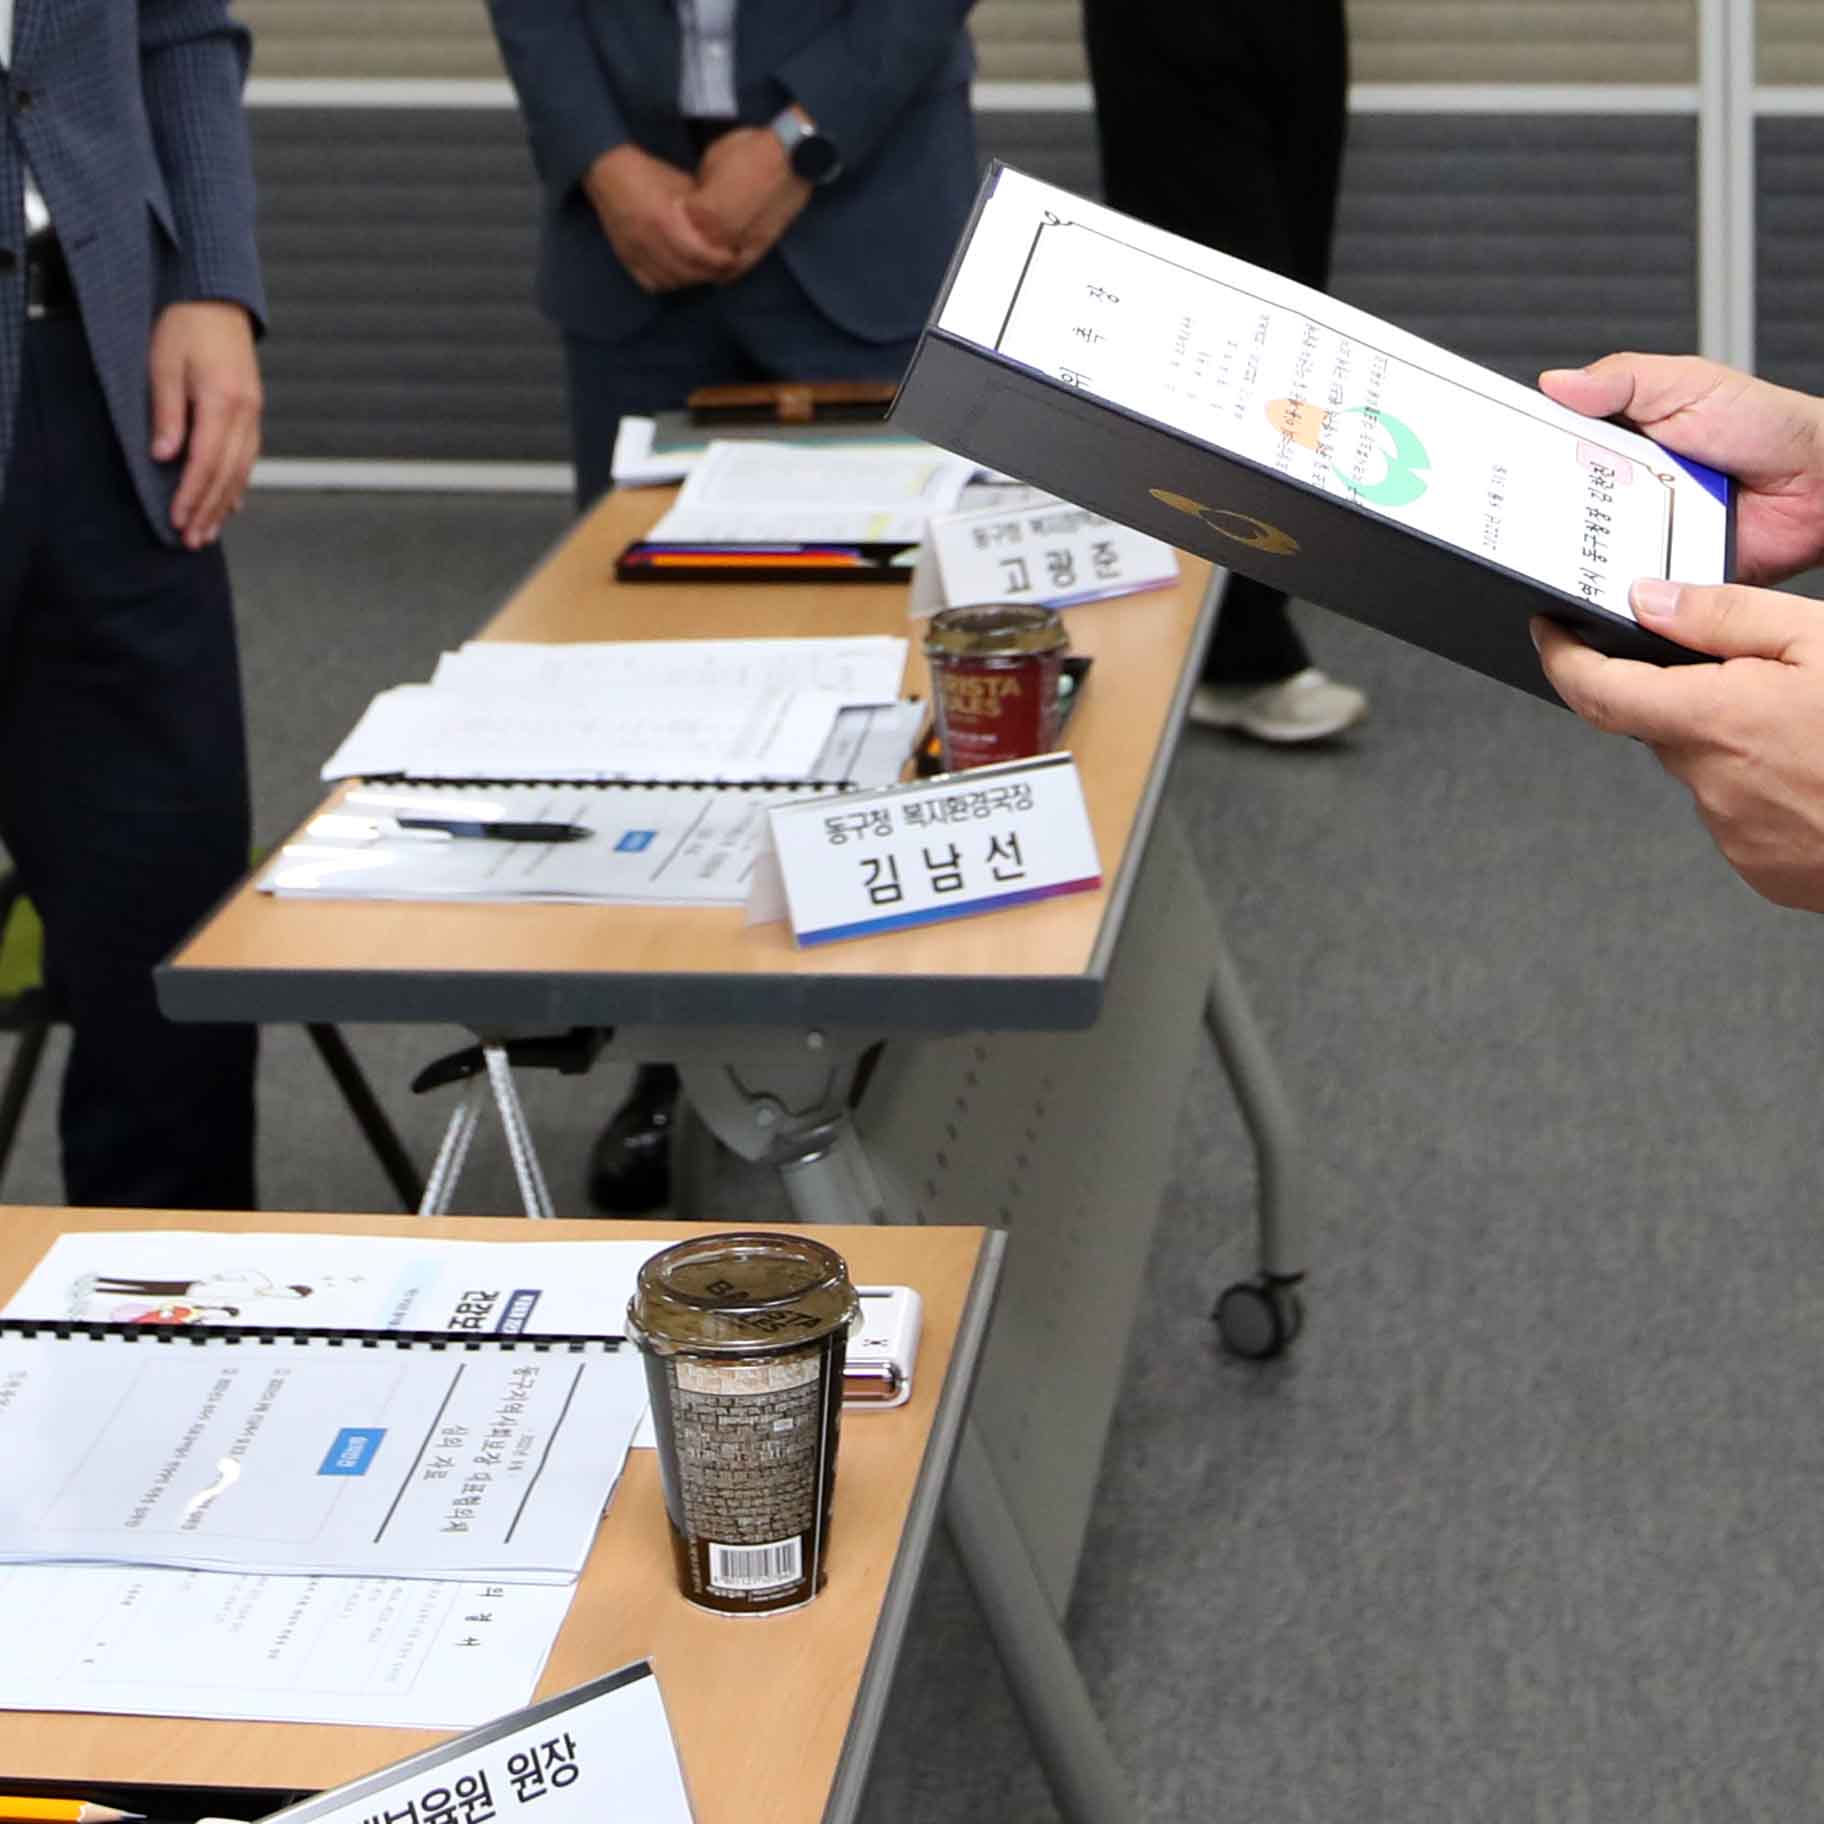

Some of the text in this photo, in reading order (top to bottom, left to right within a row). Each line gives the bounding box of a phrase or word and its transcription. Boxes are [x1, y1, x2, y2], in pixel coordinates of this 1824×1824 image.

[1582, 506, 1613, 565] 동구청장
[1578, 566, 1608, 604] 역시
[823, 781, 1035, 846] 동구청 복지환경국장
[507, 1732, 580, 1804] 원장
